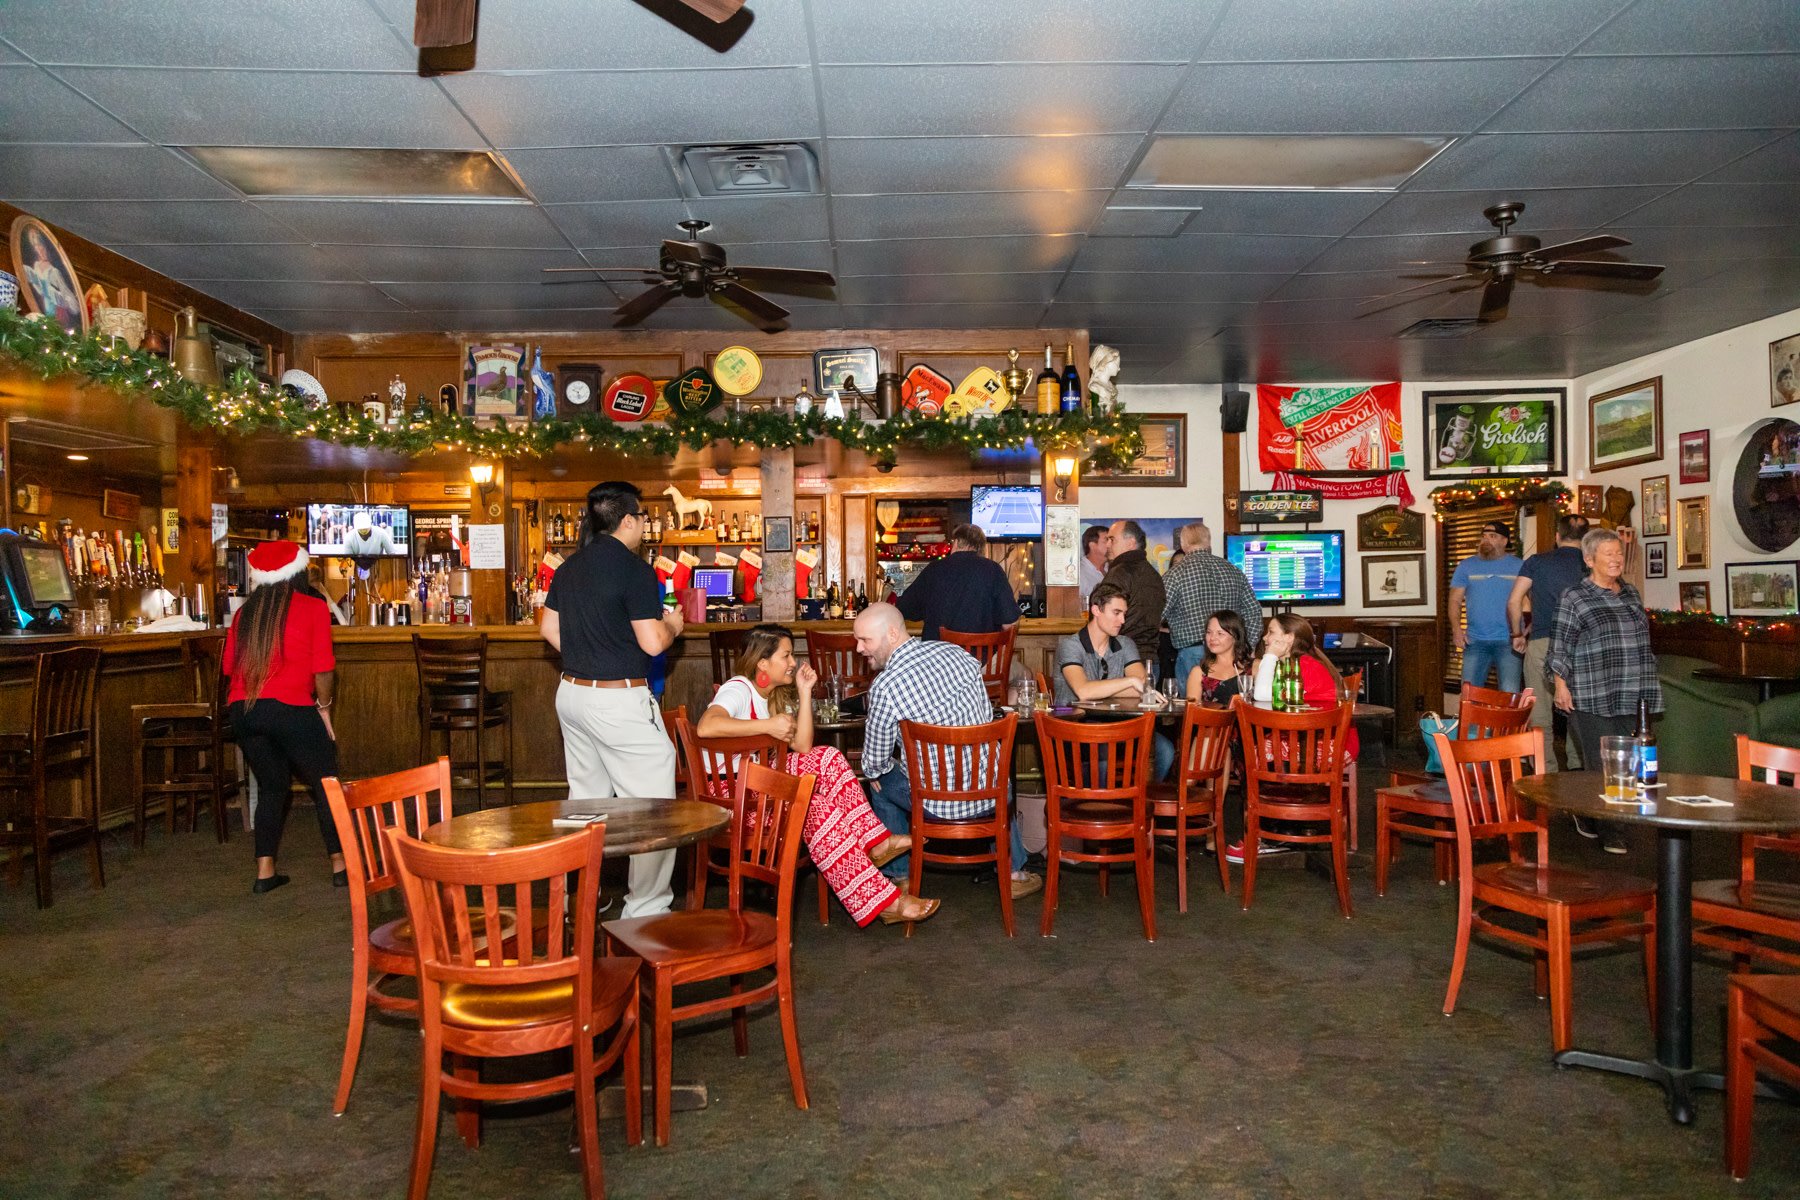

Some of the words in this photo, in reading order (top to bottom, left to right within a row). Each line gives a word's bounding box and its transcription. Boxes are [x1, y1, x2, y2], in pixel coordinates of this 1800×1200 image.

[475, 352, 498, 362] FAMOUS
[498, 351, 519, 362] GROUSE
[965, 386, 984, 399] WHITE
[616, 397, 629, 405] Black
[629, 400, 643, 408] Label
[1306, 401, 1327, 416] NEVER
[1327, 393, 1347, 407] WALK
[1305, 405, 1376, 447] LIVERPOOL
[1315, 430, 1358, 455] FOOTBALL
[1359, 417, 1378, 433] CLUB
[1481, 422, 1548, 449] Grolsch
[1267, 445, 1296, 455] Reebo
[1249, 501, 1293, 511] GOLDEN
[1295, 501, 1314, 510] TEE
